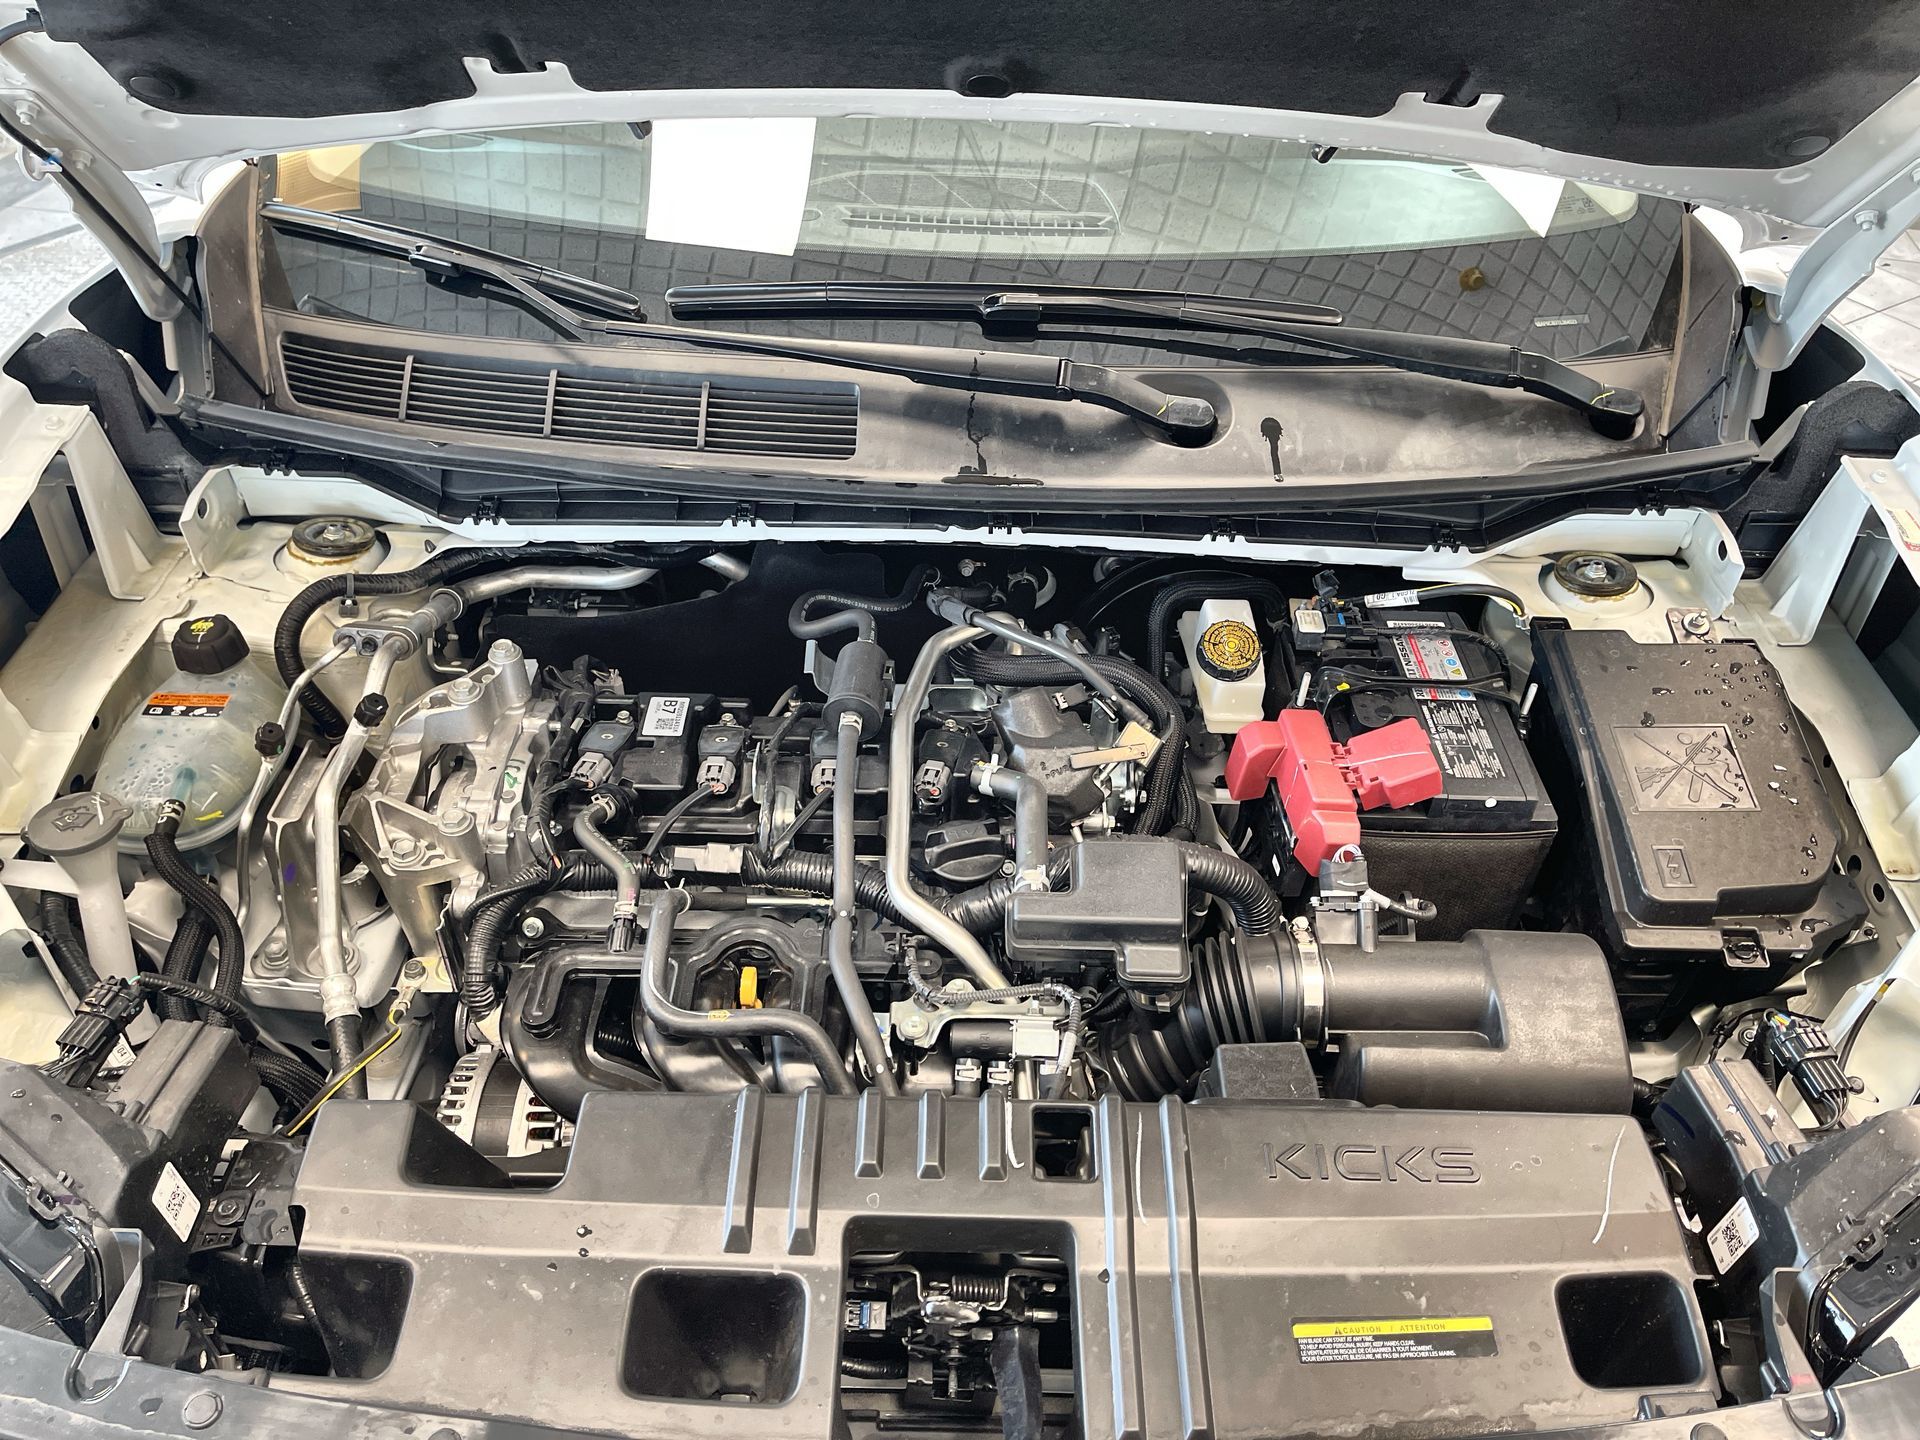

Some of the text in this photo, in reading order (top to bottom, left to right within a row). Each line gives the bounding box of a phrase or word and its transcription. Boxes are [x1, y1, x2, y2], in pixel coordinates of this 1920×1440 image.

[662, 700, 678, 714] B7
[1263, 1143, 1481, 1183] KICKS
[1342, 1326, 1381, 1334] CAUTION
[1400, 1323, 1446, 1332] ATTENTION
